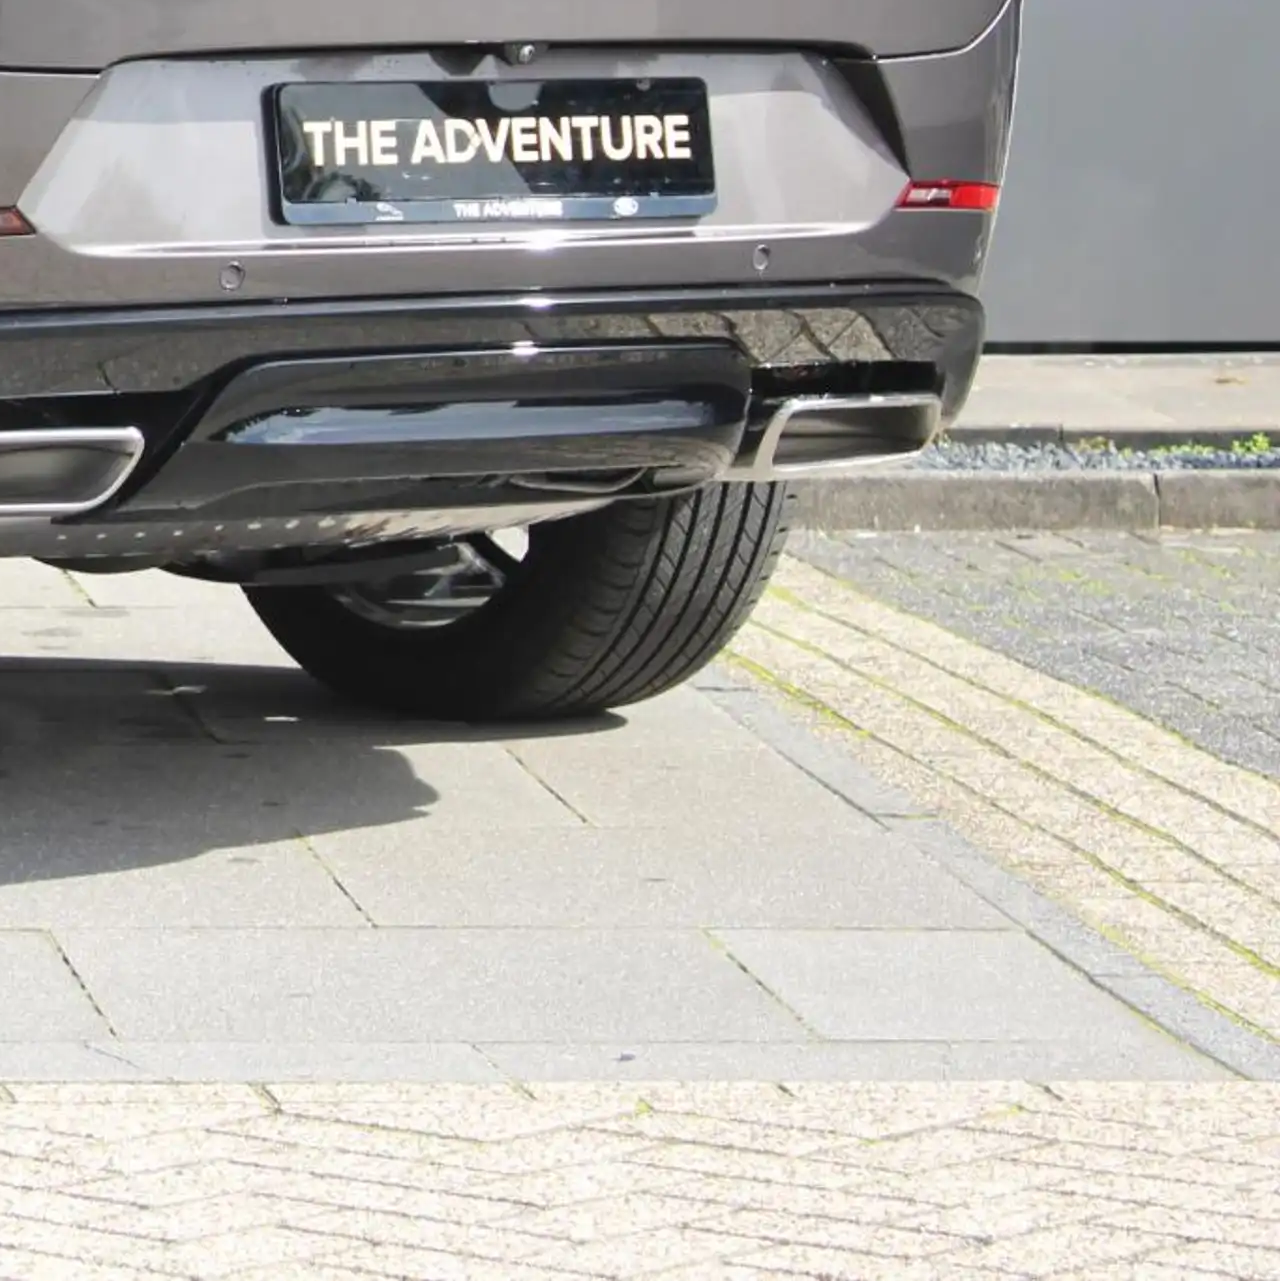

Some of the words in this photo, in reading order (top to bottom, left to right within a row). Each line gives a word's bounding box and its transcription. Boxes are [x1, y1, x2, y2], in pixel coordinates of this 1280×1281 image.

[302, 120, 398, 167] THE
[410, 114, 692, 165] ADVENTURE
[453, 203, 480, 218] THE
[483, 201, 563, 218] ADVENTURE
